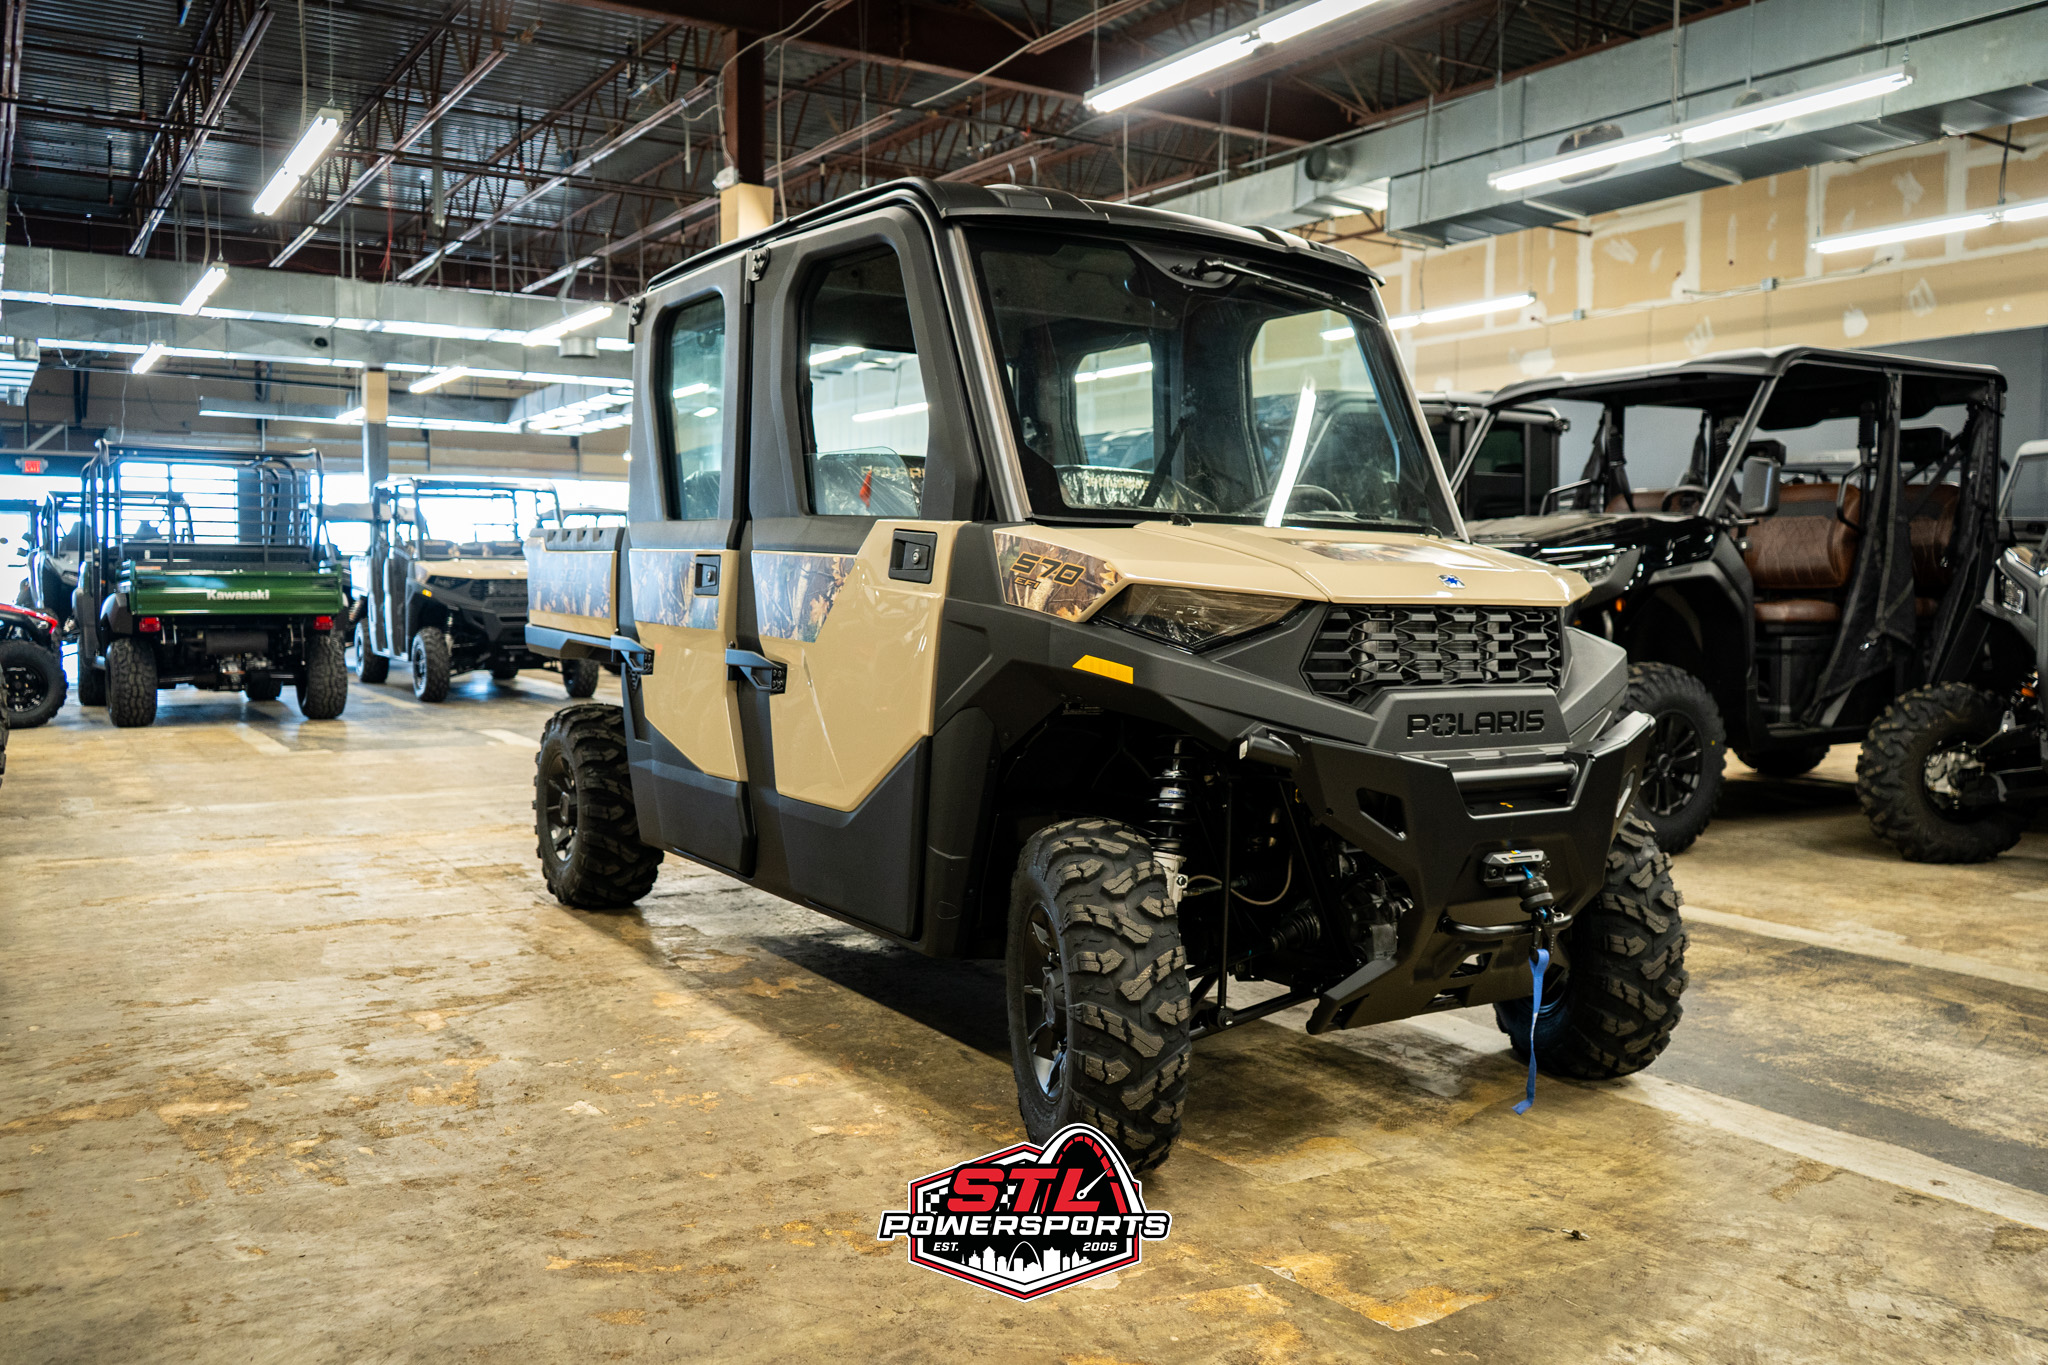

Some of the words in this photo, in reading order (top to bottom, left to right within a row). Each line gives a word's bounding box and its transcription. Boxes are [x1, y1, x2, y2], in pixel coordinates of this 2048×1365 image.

[1010, 551, 1086, 587] 570
[1014, 576, 1041, 590] EFI
[206, 589, 270, 600] Kawasaki
[1407, 710, 1545, 739] POLARIS
